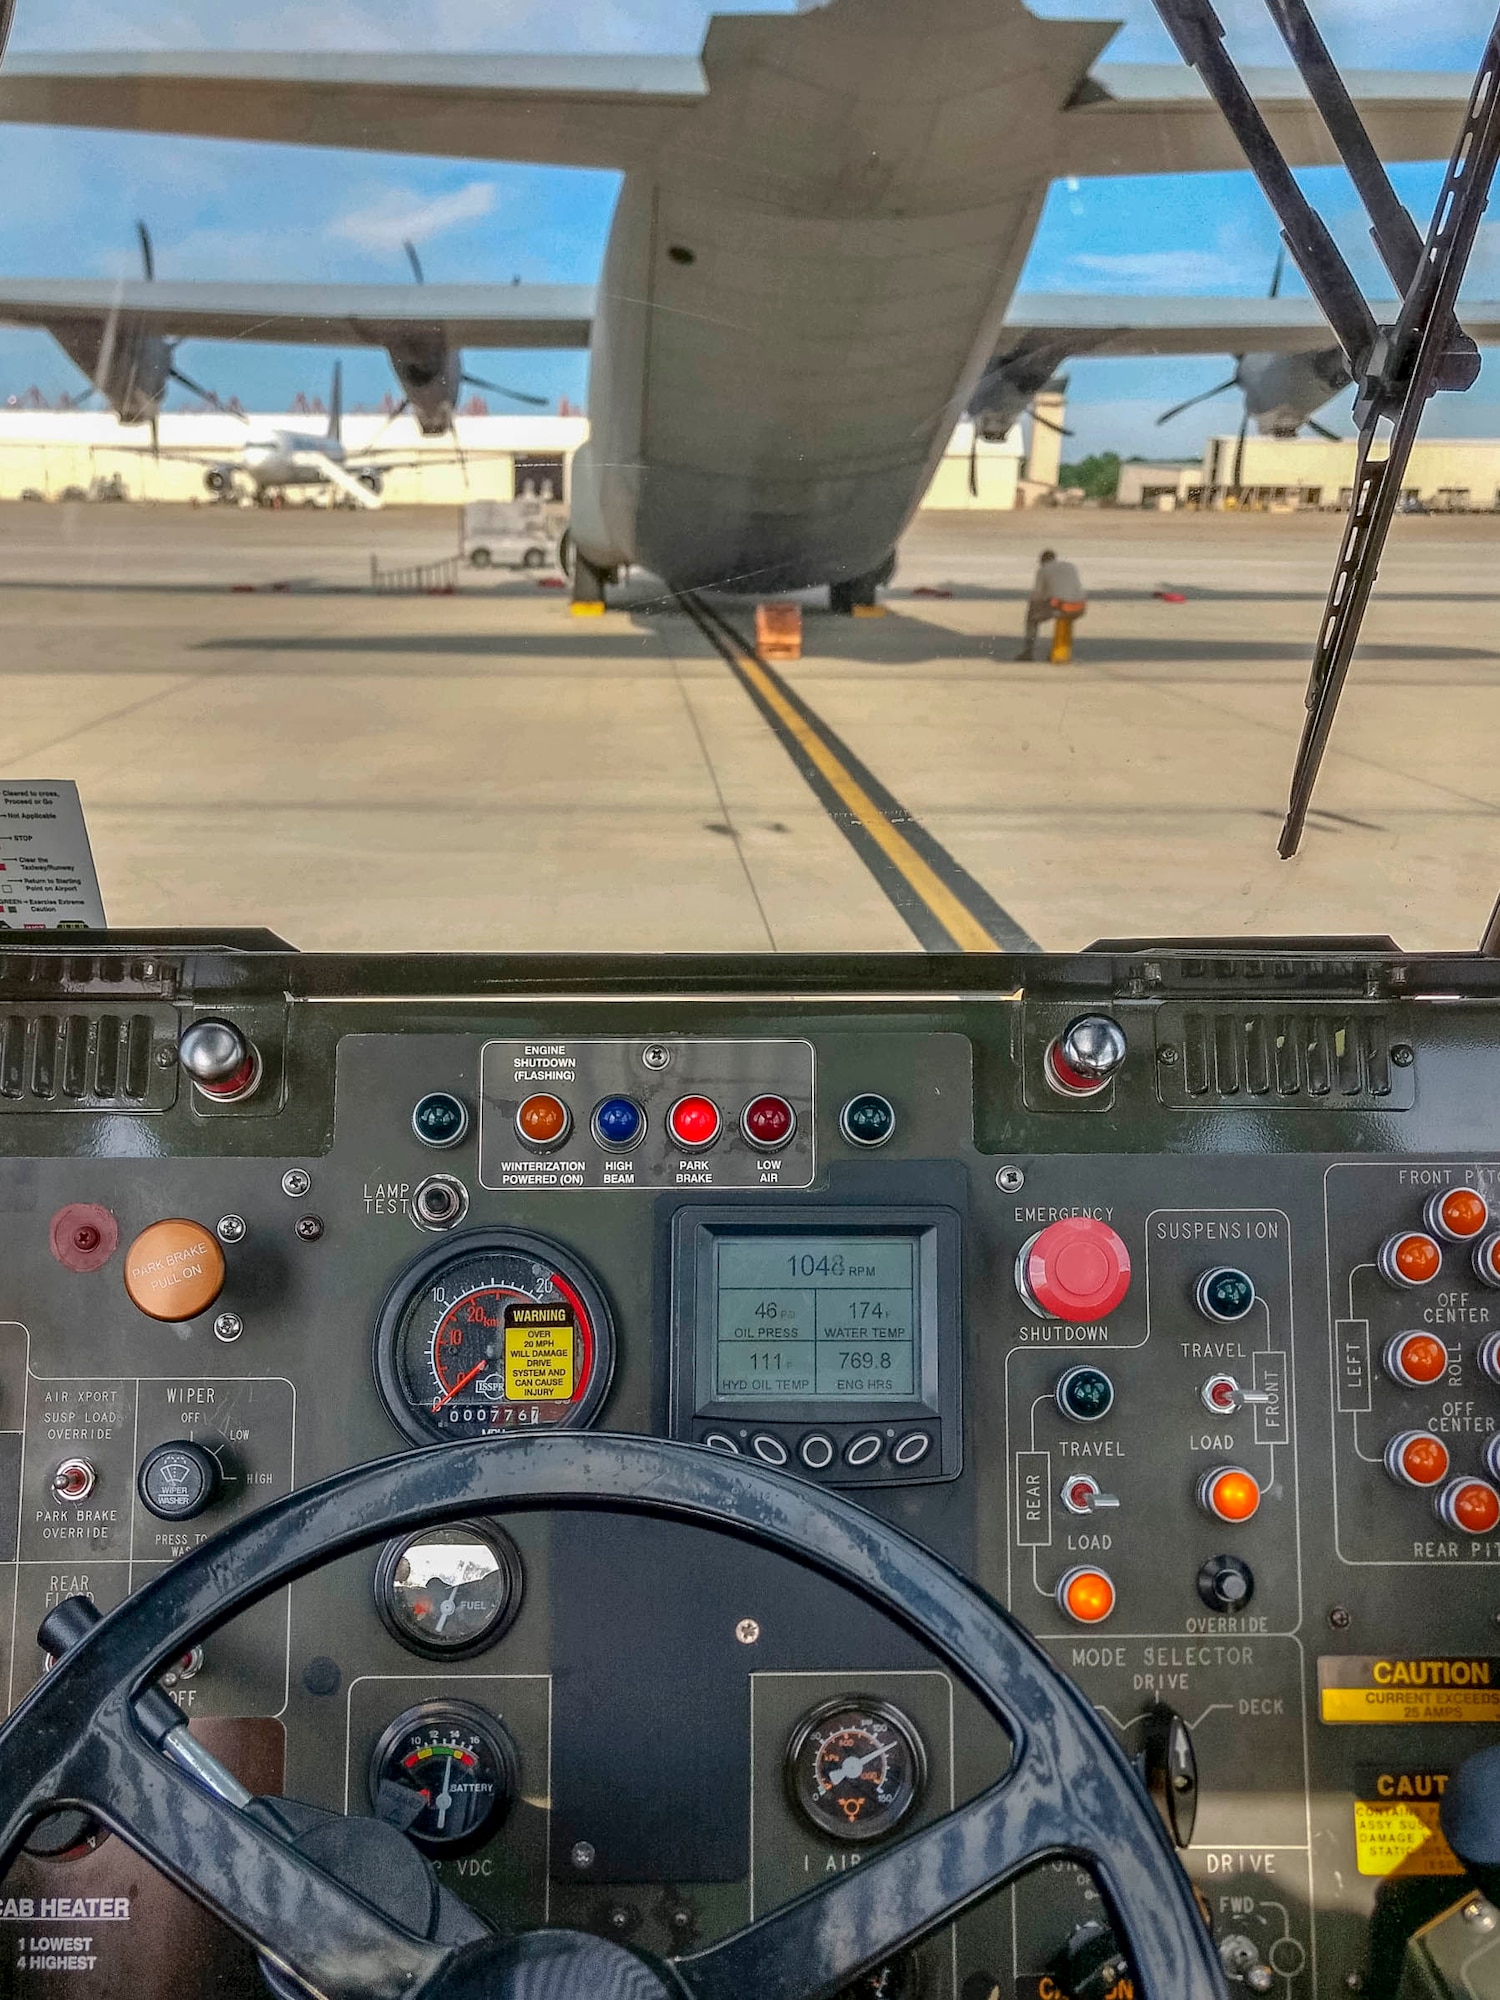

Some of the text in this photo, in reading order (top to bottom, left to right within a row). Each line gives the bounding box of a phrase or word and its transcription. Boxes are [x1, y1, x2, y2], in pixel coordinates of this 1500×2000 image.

[55, 878, 82, 886] Starting
[524, 1046, 565, 1055] ENGINE
[514, 1058, 576, 1068] SHUTDOWN
[514, 1070, 576, 1082] (FLASHING)
[501, 1161, 586, 1171] WINTERIZATION
[605, 1161, 633, 1172] HIGH
[679, 1161, 710, 1171] PARK
[757, 1161, 782, 1171] LOW
[502, 1173, 584, 1186] POWERED (ON)
[603, 1174, 635, 1184] BEAM
[676, 1174, 713, 1184] BRAKE
[759, 1173, 779, 1183] AIR
[1399, 1170, 1453, 1184] FRONT
[363, 1184, 410, 1199] LAMP
[363, 1199, 409, 1214] TEST
[1014, 1207, 1114, 1222] EMERGENCY
[1156, 1222, 1280, 1240] SUSPENSION
[132, 1242, 208, 1279] PARK BRAKE
[150, 1263, 202, 1292] PULL ON
[849, 1266, 876, 1277] RPM
[536, 1278, 553, 1294] 20
[432, 1287, 446, 1303] 10
[1438, 1293, 1470, 1307] OFF
[467, 1306, 485, 1324] 20
[513, 1309, 566, 1322] WARNING
[754, 1302, 778, 1319] 46
[849, 1302, 883, 1319] 174
[1424, 1308, 1490, 1323] CENTER
[528, 1330, 551, 1338] OVER
[734, 1328, 799, 1339] OIL PRESS
[824, 1328, 906, 1338] WATER TEMP
[1019, 1327, 1108, 1341] SHUTDOWN
[524, 1340, 554, 1349] 20 MPH
[1180, 1343, 1247, 1358] TRAVEL
[510, 1349, 568, 1358] WILL DAMAGE
[527, 1359, 552, 1367] DRIVE
[749, 1353, 781, 1370] 111
[838, 1352, 892, 1370] 769.8
[1346, 1342, 1362, 1388] LEFT
[1448, 1342, 1462, 1387] ROLL
[512, 1368, 566, 1377] SYSTEM AND
[515, 1378, 564, 1387] CAN CAUSE
[722, 1380, 809, 1390] HYD OIL TEMP
[837, 1380, 893, 1390] ENG HRS
[45, 1391, 117, 1402] AIR XPORT
[166, 1388, 215, 1403] WIPER
[524, 1388, 554, 1397] INJURY
[1265, 1370, 1280, 1428] FRONT
[1442, 1402, 1476, 1416] OFF
[44, 1412, 116, 1423] SUSP LOAD
[181, 1412, 200, 1423] OFF
[1428, 1418, 1495, 1432] CENTER
[47, 1428, 113, 1440] OVERRIDE
[229, 1429, 250, 1441] LOW
[1190, 1435, 1234, 1450] LOAD
[1059, 1442, 1126, 1457] TRAVEL
[247, 1473, 273, 1485] HIGH
[161, 1486, 188, 1494] WIPER
[158, 1497, 189, 1505] WASHER
[1026, 1475, 1041, 1521] REAR
[36, 1510, 117, 1522] PARK BRAKE
[42, 1527, 109, 1539] OVERRIDE
[155, 1534, 188, 1545] PRESS
[1067, 1535, 1112, 1550] LOAD
[1414, 1542, 1459, 1557] REAR
[50, 1575, 89, 1591] REAR
[461, 1601, 486, 1610] FUEL
[1186, 1617, 1268, 1633] OVERRIDE
[1072, 1647, 1253, 1666] MODE SELECTOR
[1372, 1661, 1490, 1684] CAUTION
[1133, 1674, 1189, 1690] DRIVE
[1365, 1692, 1500, 1704] CURRENT EXCEEDS
[1239, 1699, 1283, 1714] DECK
[1403, 1707, 1463, 1718] 25 AMPS
[429, 1730, 439, 1738] 12
[450, 1730, 460, 1738] 14
[469, 1736, 480, 1744] 16
[411, 1737, 421, 1745] 10
[450, 1784, 494, 1793] BATTERY
[1361, 1821, 1391, 1830] ASSY
[1360, 1834, 1412, 1843] DAMAGE
[457, 1860, 492, 1876] VDC
[1207, 1854, 1276, 1873] DRIVE
[0, 1898, 130, 1918] AB HEATER
[1220, 1896, 1255, 1913] FWD
[19, 1937, 93, 1951] 1 LOWEST
[17, 1956, 97, 1970] 4 HIGHEST
